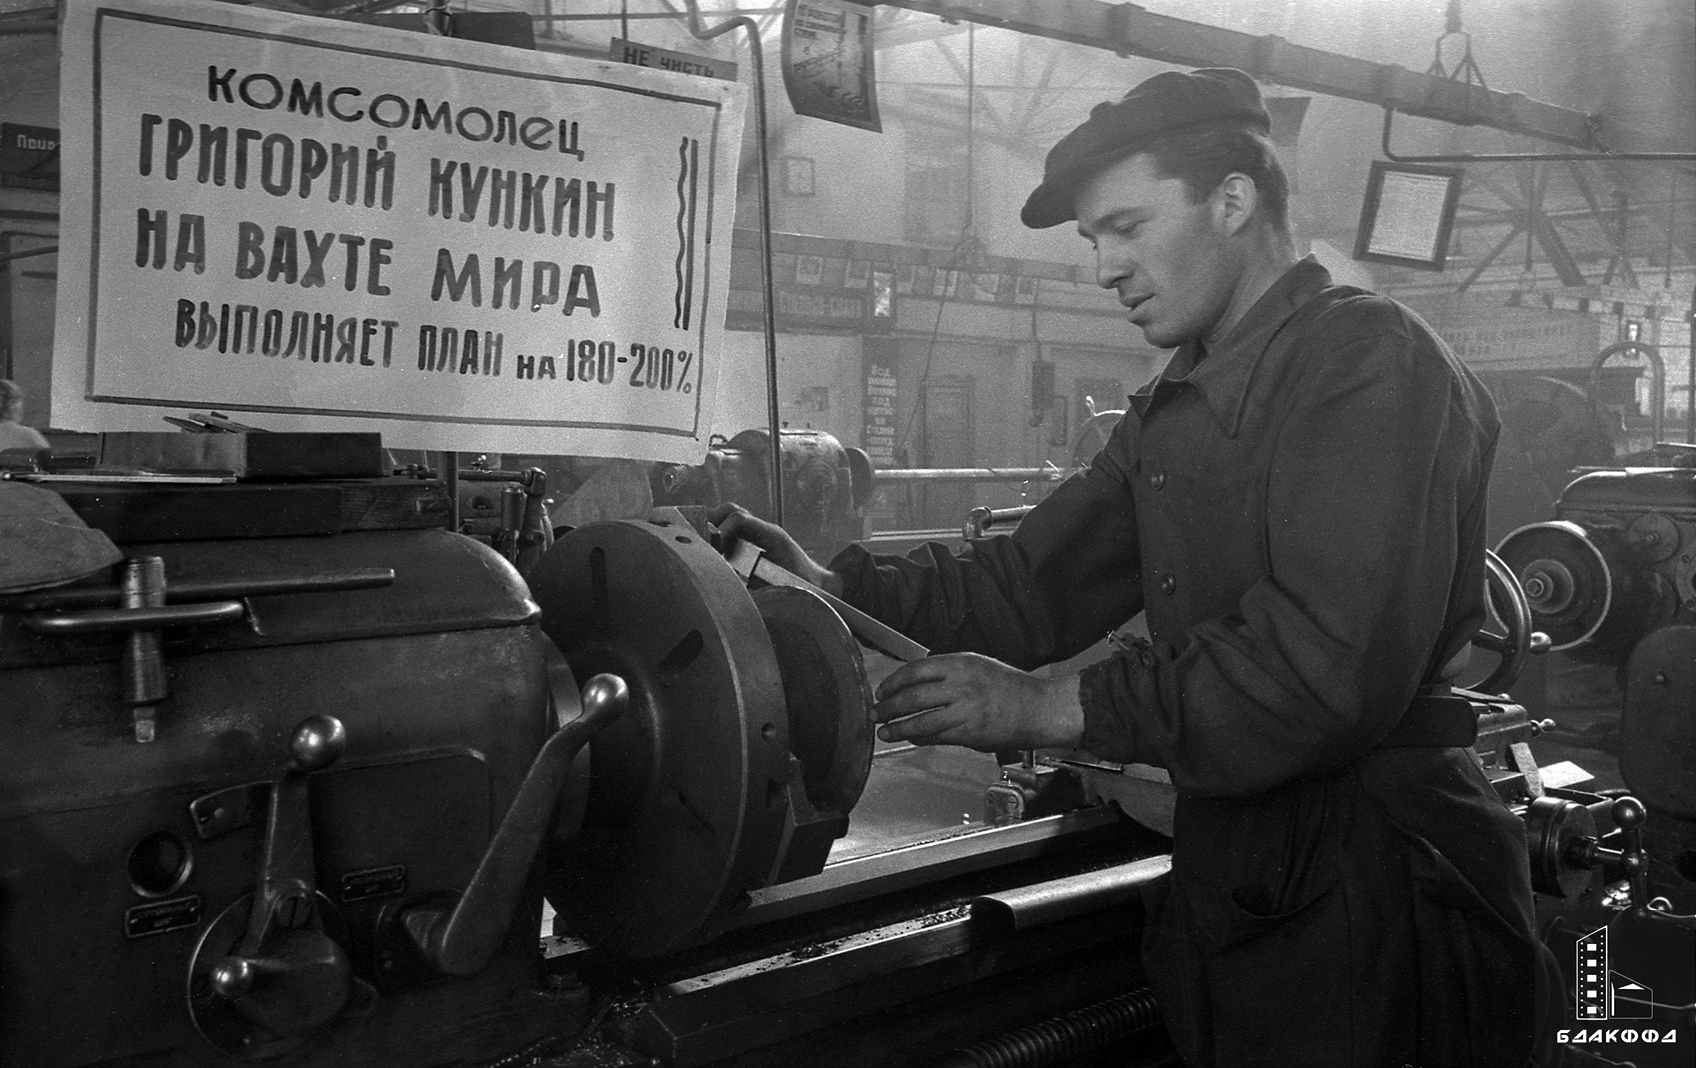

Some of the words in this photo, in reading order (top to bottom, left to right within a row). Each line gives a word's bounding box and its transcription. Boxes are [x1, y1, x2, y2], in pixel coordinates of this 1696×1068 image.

[624, 47, 650, 67] НЕ
[138, 113, 397, 211] ГРИГОРИЙ
[428, 157, 616, 242] КУНКИН
[135, 208, 206, 275] НА
[235, 221, 394, 297] ВАХТЕ
[431, 248, 601, 318] МИРА
[174, 298, 400, 368] ВЫПОЛНЯЕТ
[417, 325, 504, 377] ПЛАН
[566, 339, 694, 394] 180-200%
